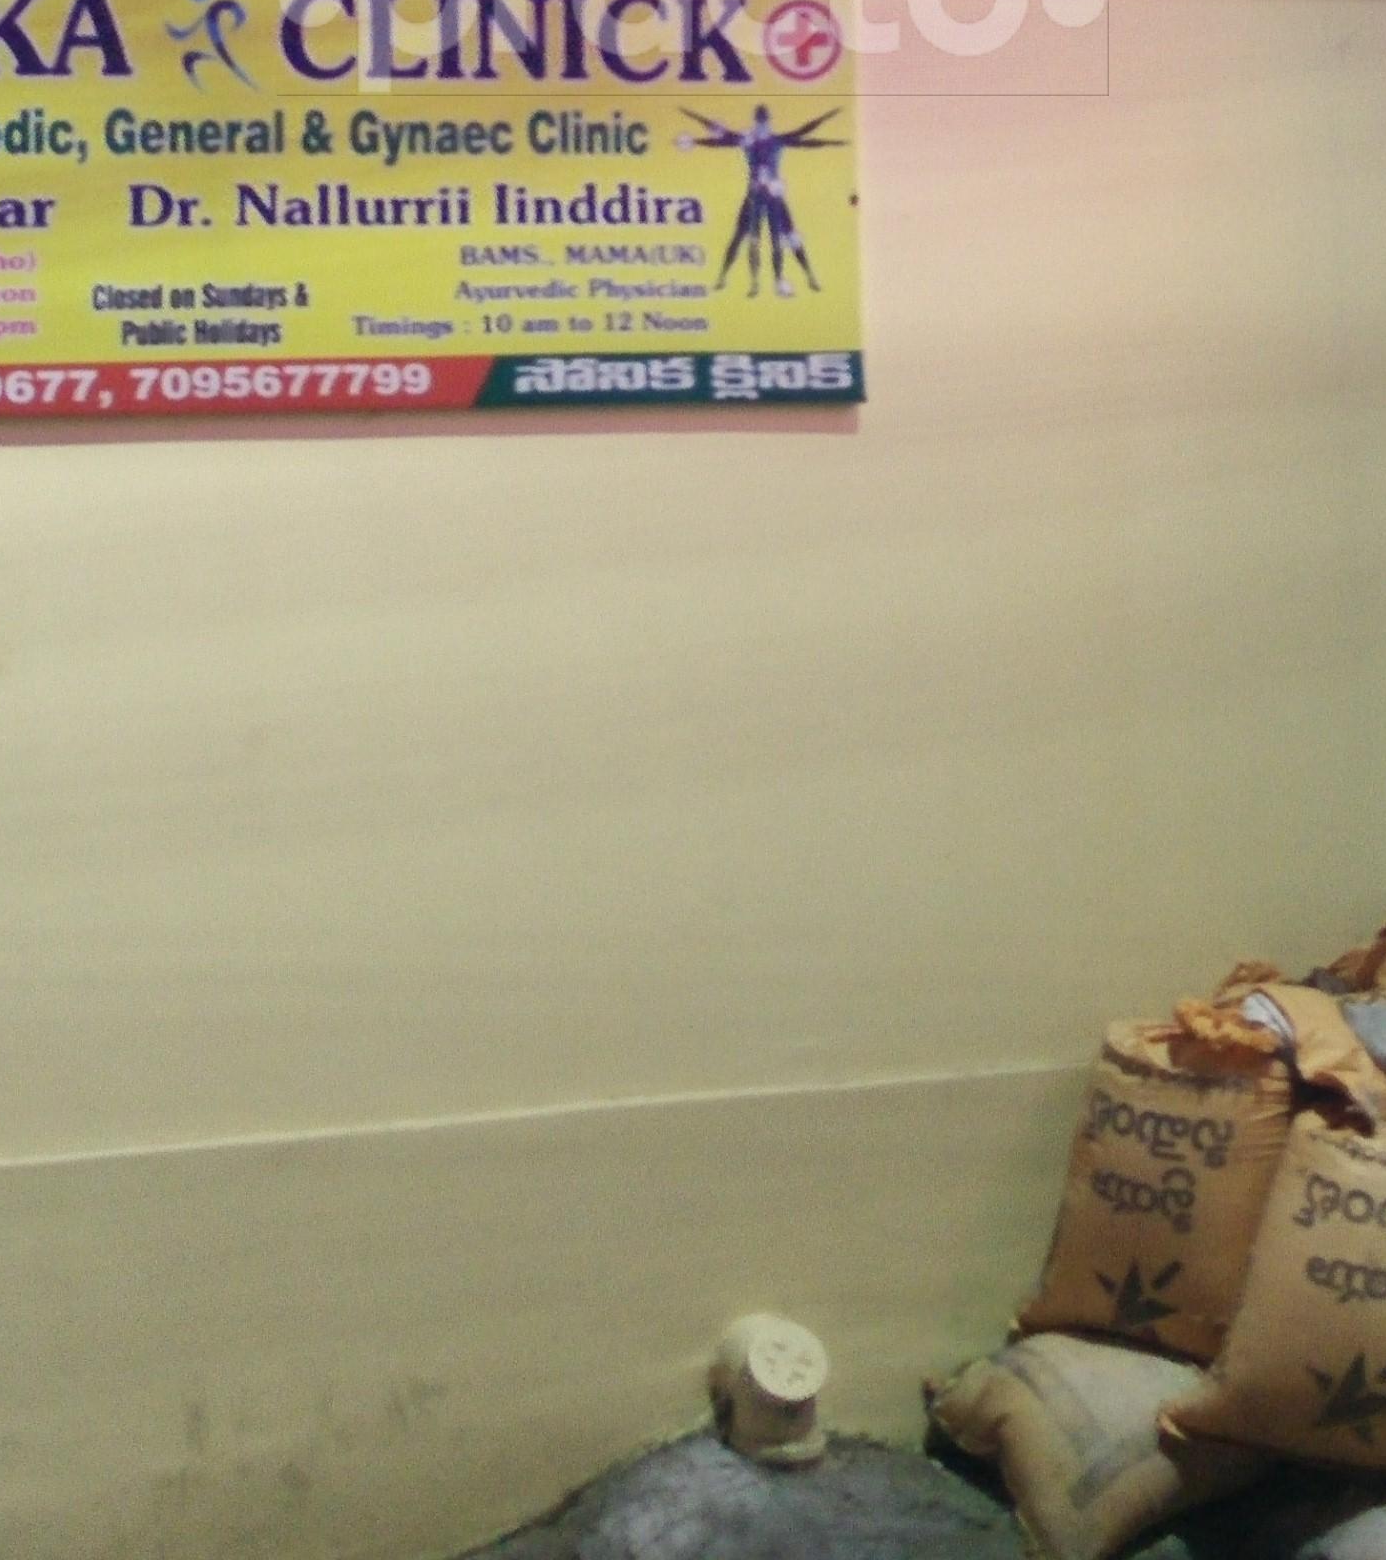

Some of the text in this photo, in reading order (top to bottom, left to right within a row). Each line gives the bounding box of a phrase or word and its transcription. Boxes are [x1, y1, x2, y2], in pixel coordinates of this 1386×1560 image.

[104, 108, 285, 156] General
[301, 108, 335, 155] &
[349, 109, 513, 167] Gynaec
[527, 109, 649, 155] Clinic
[128, 183, 212, 228] Dr.
[235, 183, 471, 227] Nallurrii
[92, 283, 163, 310] Closed
[170, 288, 196, 309] on
[202, 282, 288, 310] Sundays
[456, 278, 708, 302] Ayurvedic Physician
[121, 318, 282, 347] Public Holidays
[352, 315, 453, 339] Timings
[483, 313, 513, 334] 10
[521, 317, 560, 333] am
[569, 316, 594, 332] to
[604, 311, 633, 332] 12
[642, 311, 709, 332] Noon
[129, 362, 431, 401] 7095677799
